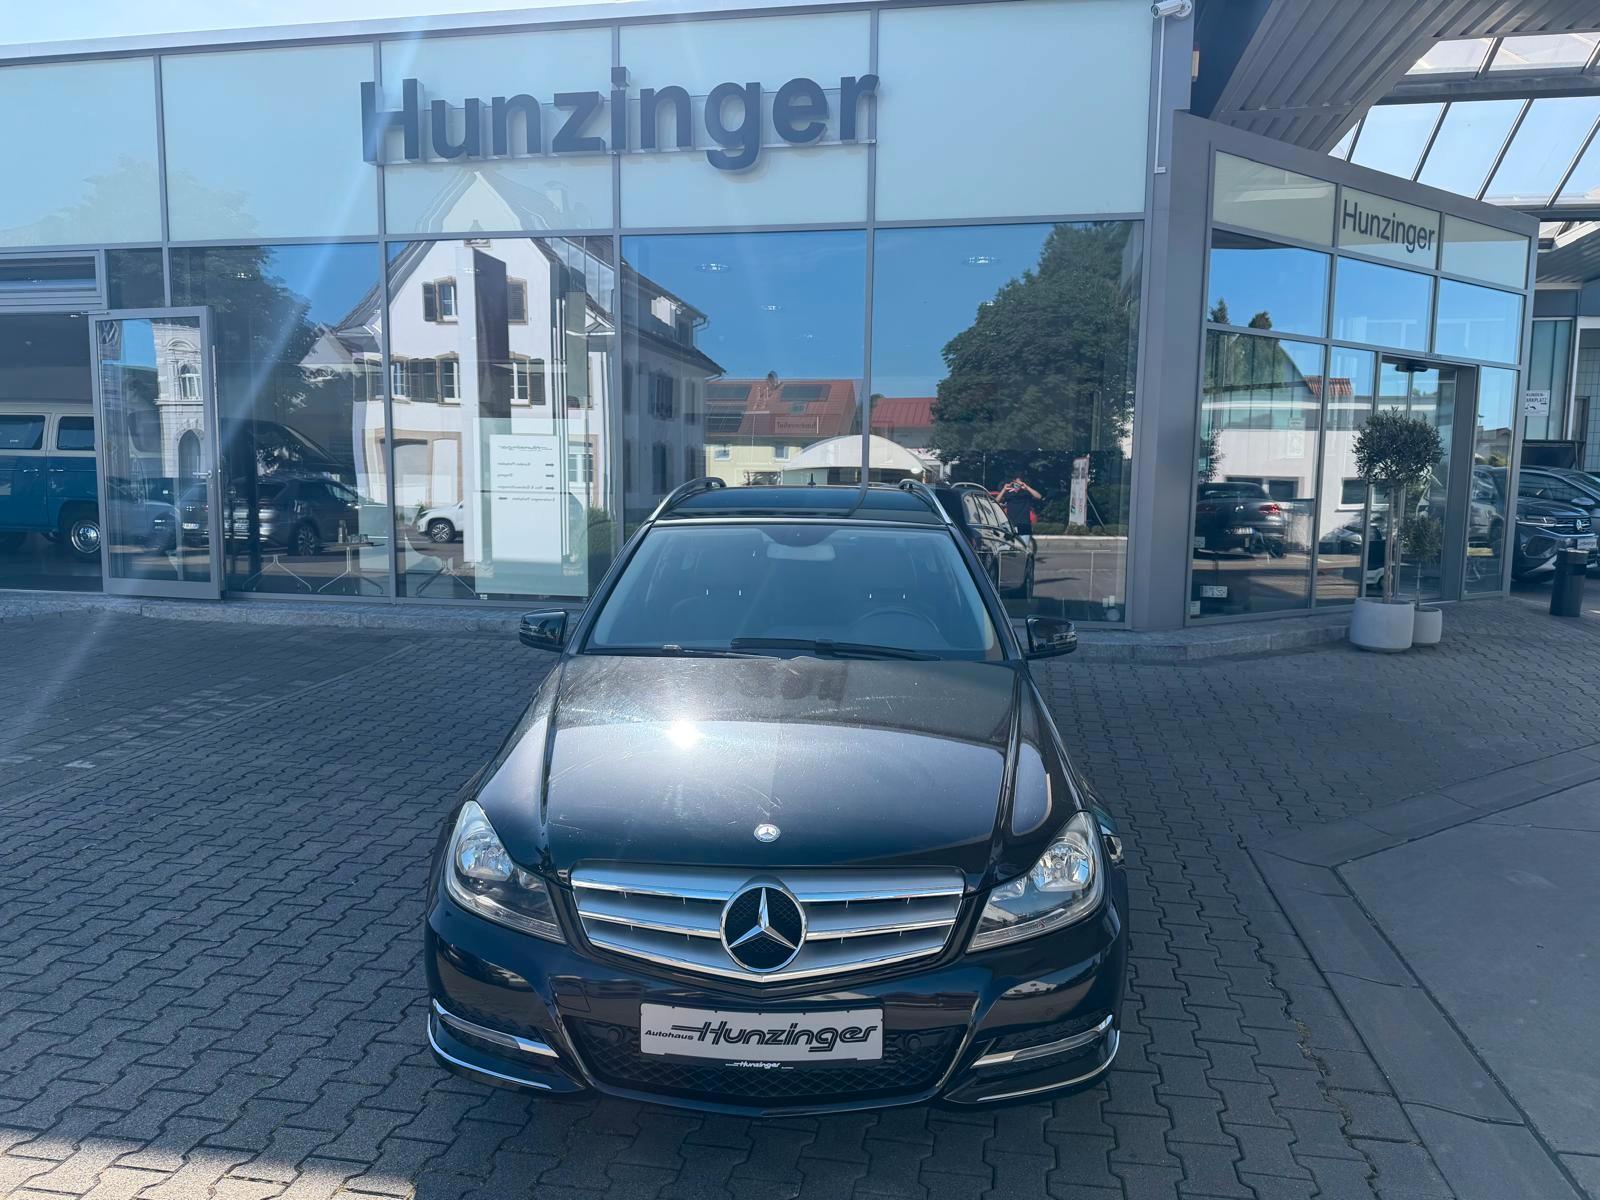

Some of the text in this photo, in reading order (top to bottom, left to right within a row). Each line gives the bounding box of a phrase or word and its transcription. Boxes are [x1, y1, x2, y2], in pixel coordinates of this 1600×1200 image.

[361, 66, 880, 173] Hunzinger
[1342, 199, 1435, 253] Hunzinger
[644, 1020, 878, 1052] Autohaus Hunzinger
[726, 1061, 781, 1070] Hunzinger
